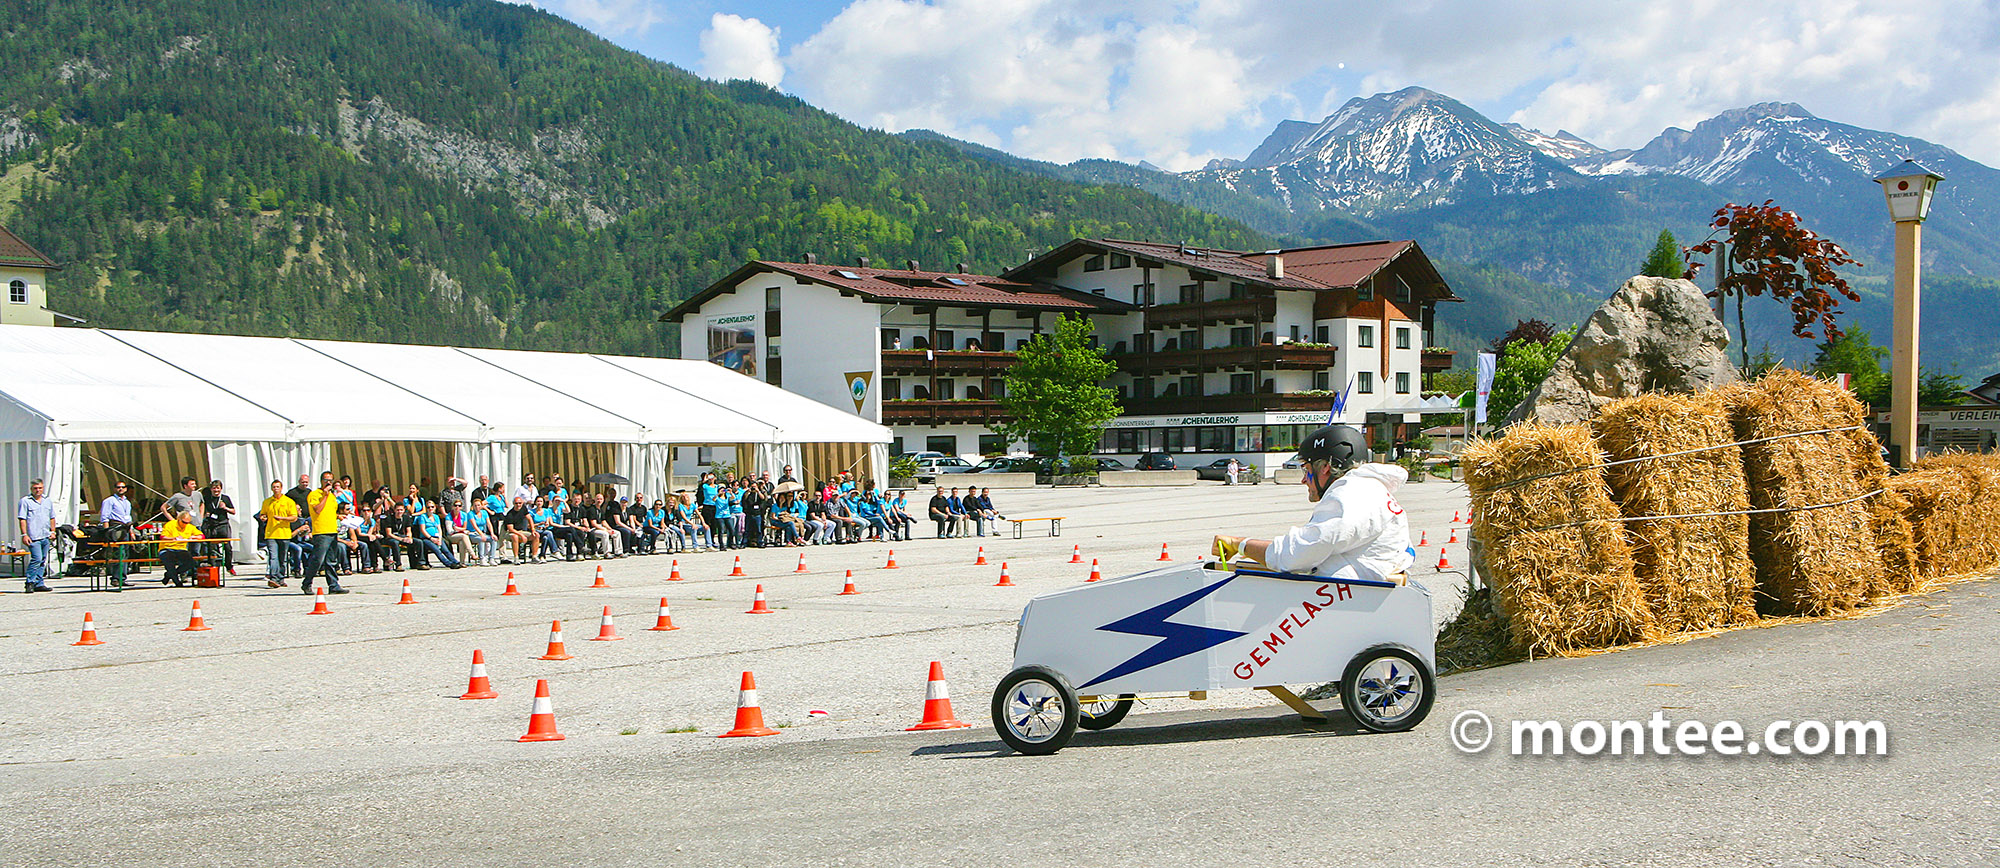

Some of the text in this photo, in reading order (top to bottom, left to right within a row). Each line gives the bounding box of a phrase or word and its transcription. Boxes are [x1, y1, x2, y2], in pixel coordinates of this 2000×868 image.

[1950, 411, 2000, 420] VERLEIH
[1181, 416, 1239, 425] ACHENTALERHOF
[1233, 583, 1353, 680] GEMFLASH
